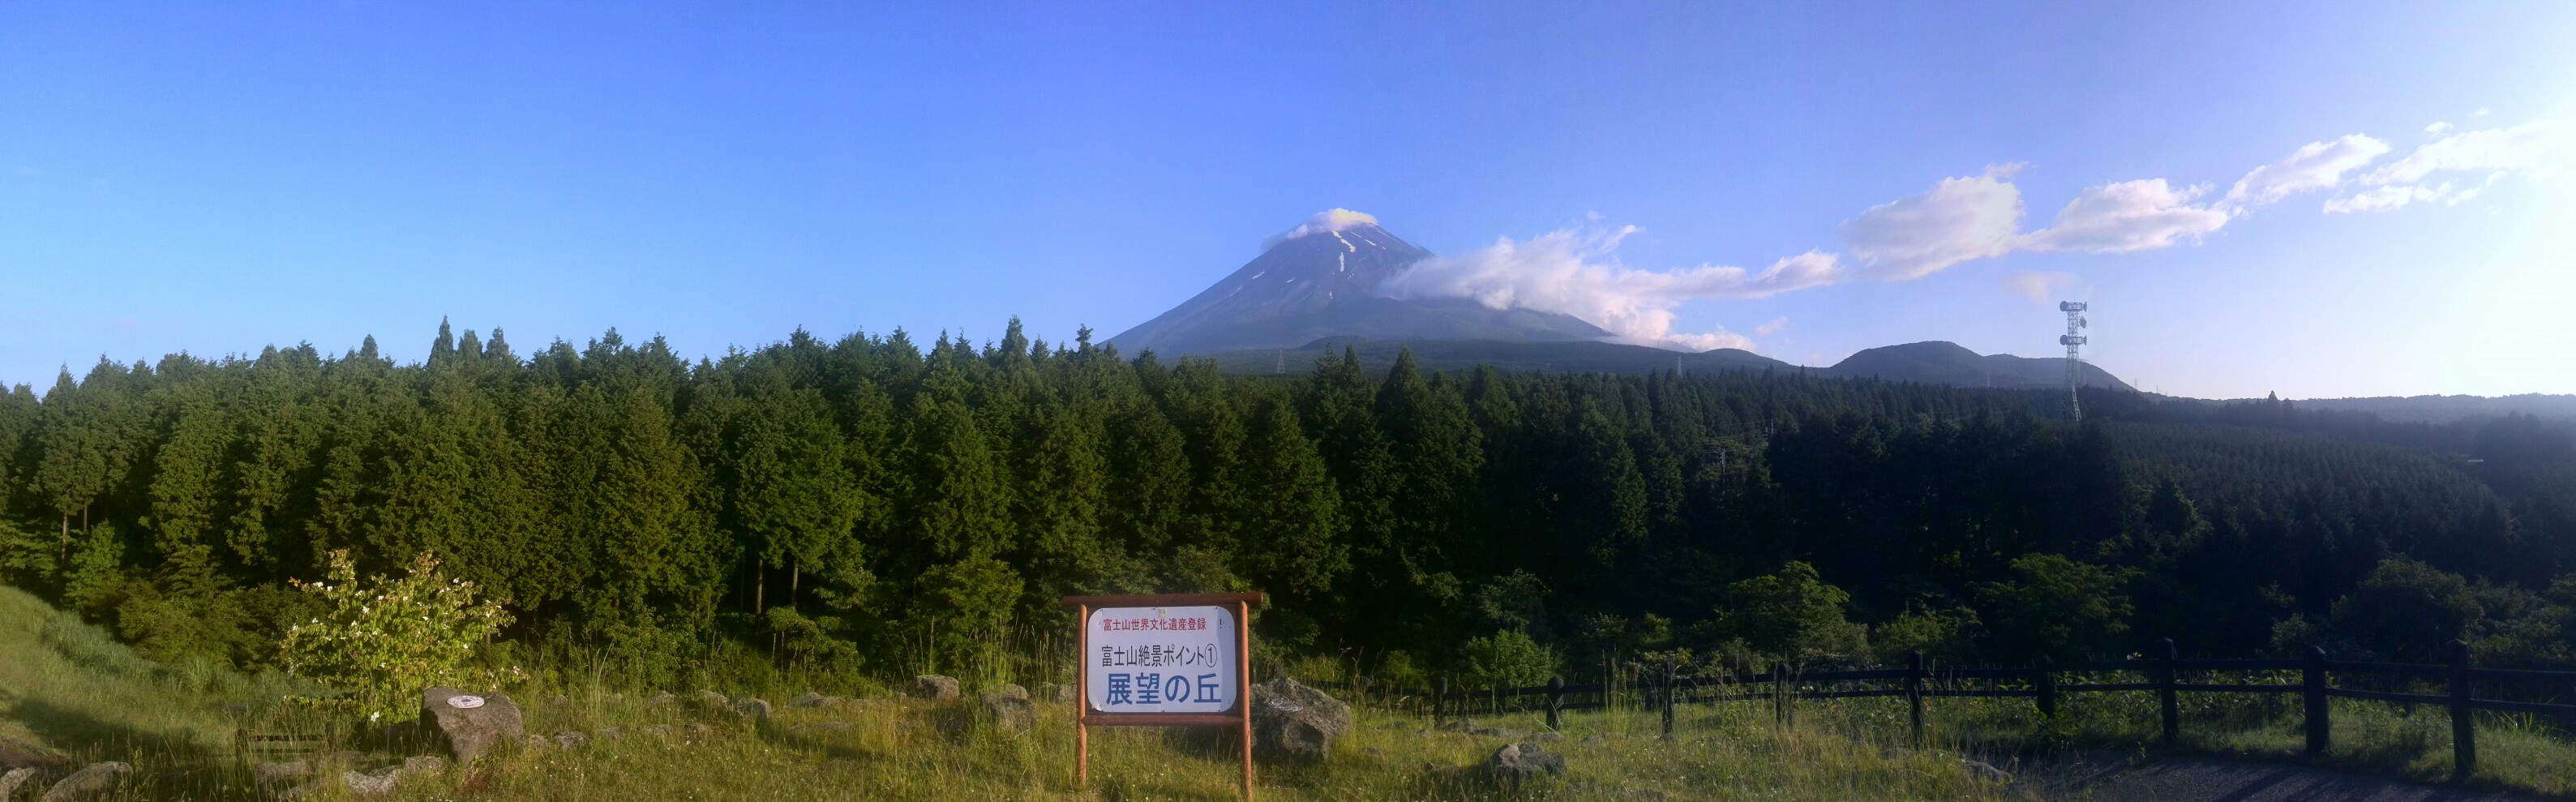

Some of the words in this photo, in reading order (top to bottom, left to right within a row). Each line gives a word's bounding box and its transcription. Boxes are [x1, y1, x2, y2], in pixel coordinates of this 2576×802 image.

[1104, 618, 1207, 631] 富士山世界文化遺産登録
[1106, 672, 1222, 706] 展望の丘
